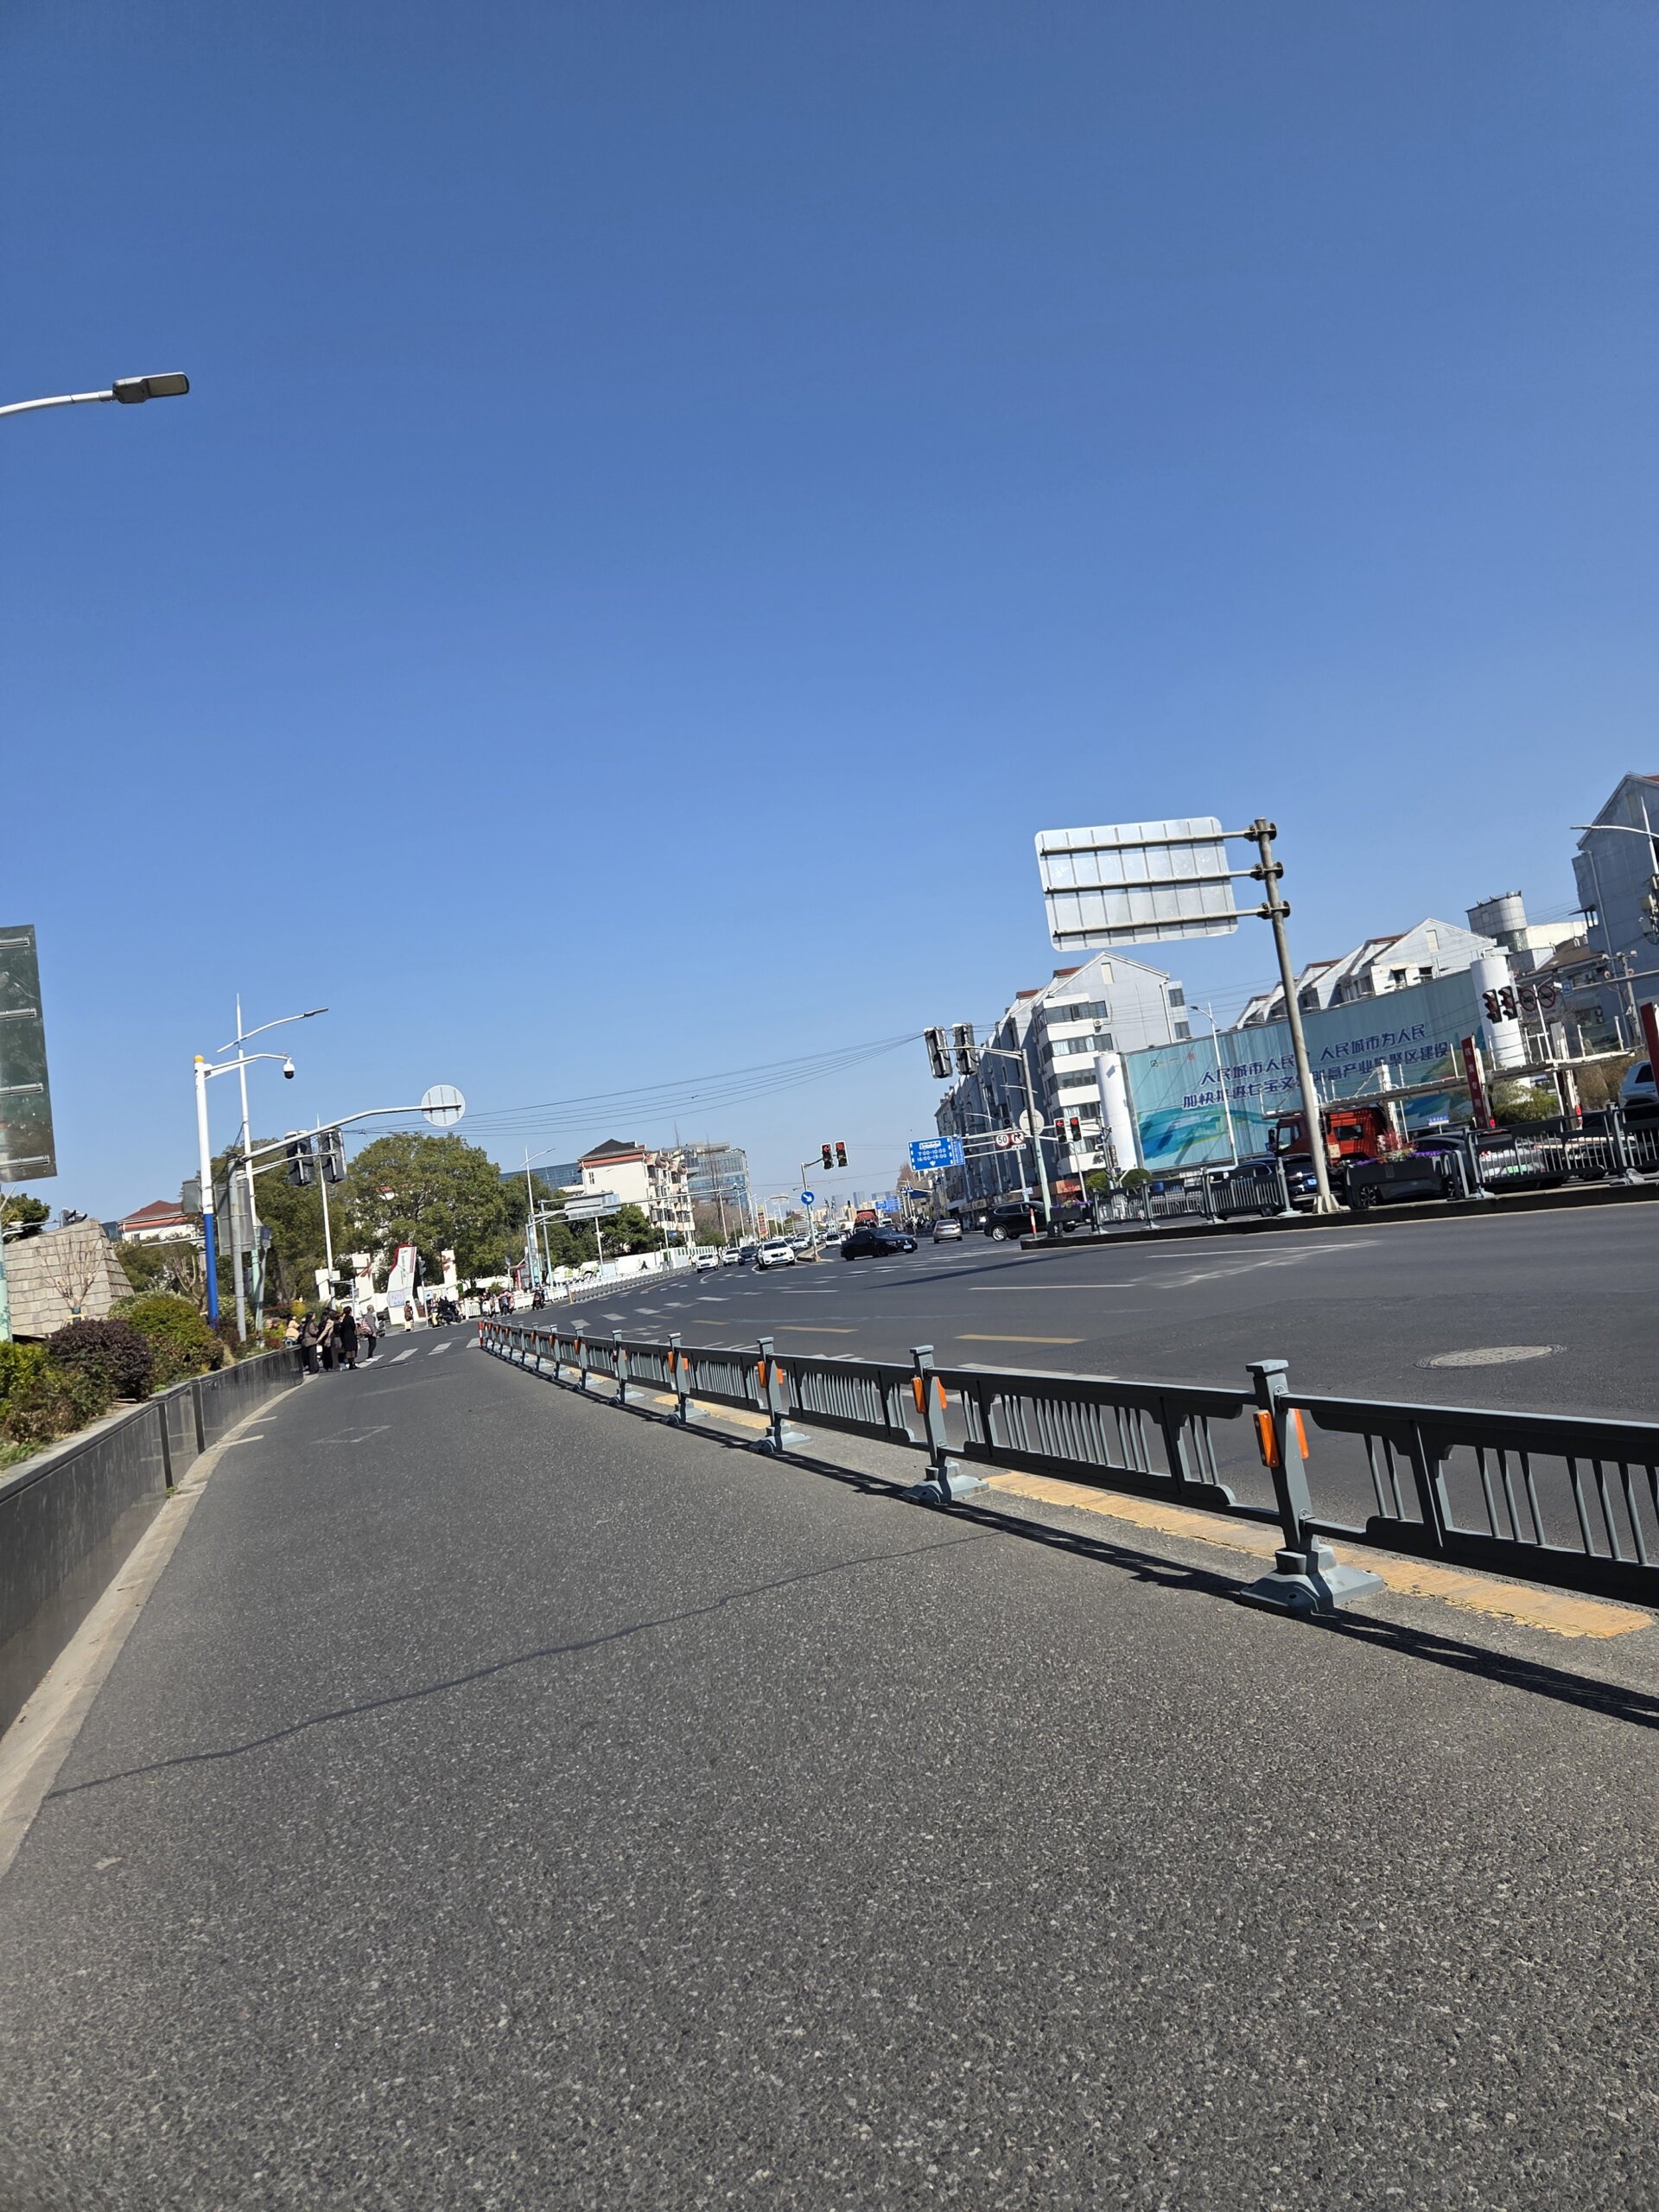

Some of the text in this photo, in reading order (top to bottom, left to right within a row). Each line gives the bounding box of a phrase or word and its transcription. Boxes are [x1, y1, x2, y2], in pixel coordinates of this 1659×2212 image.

[1183, 1041, 1448, 1109] 加快推进七宝文创意产业集聚区建设
[1200, 1023, 1426, 1085] 人民城市人民 人民城市为人民
